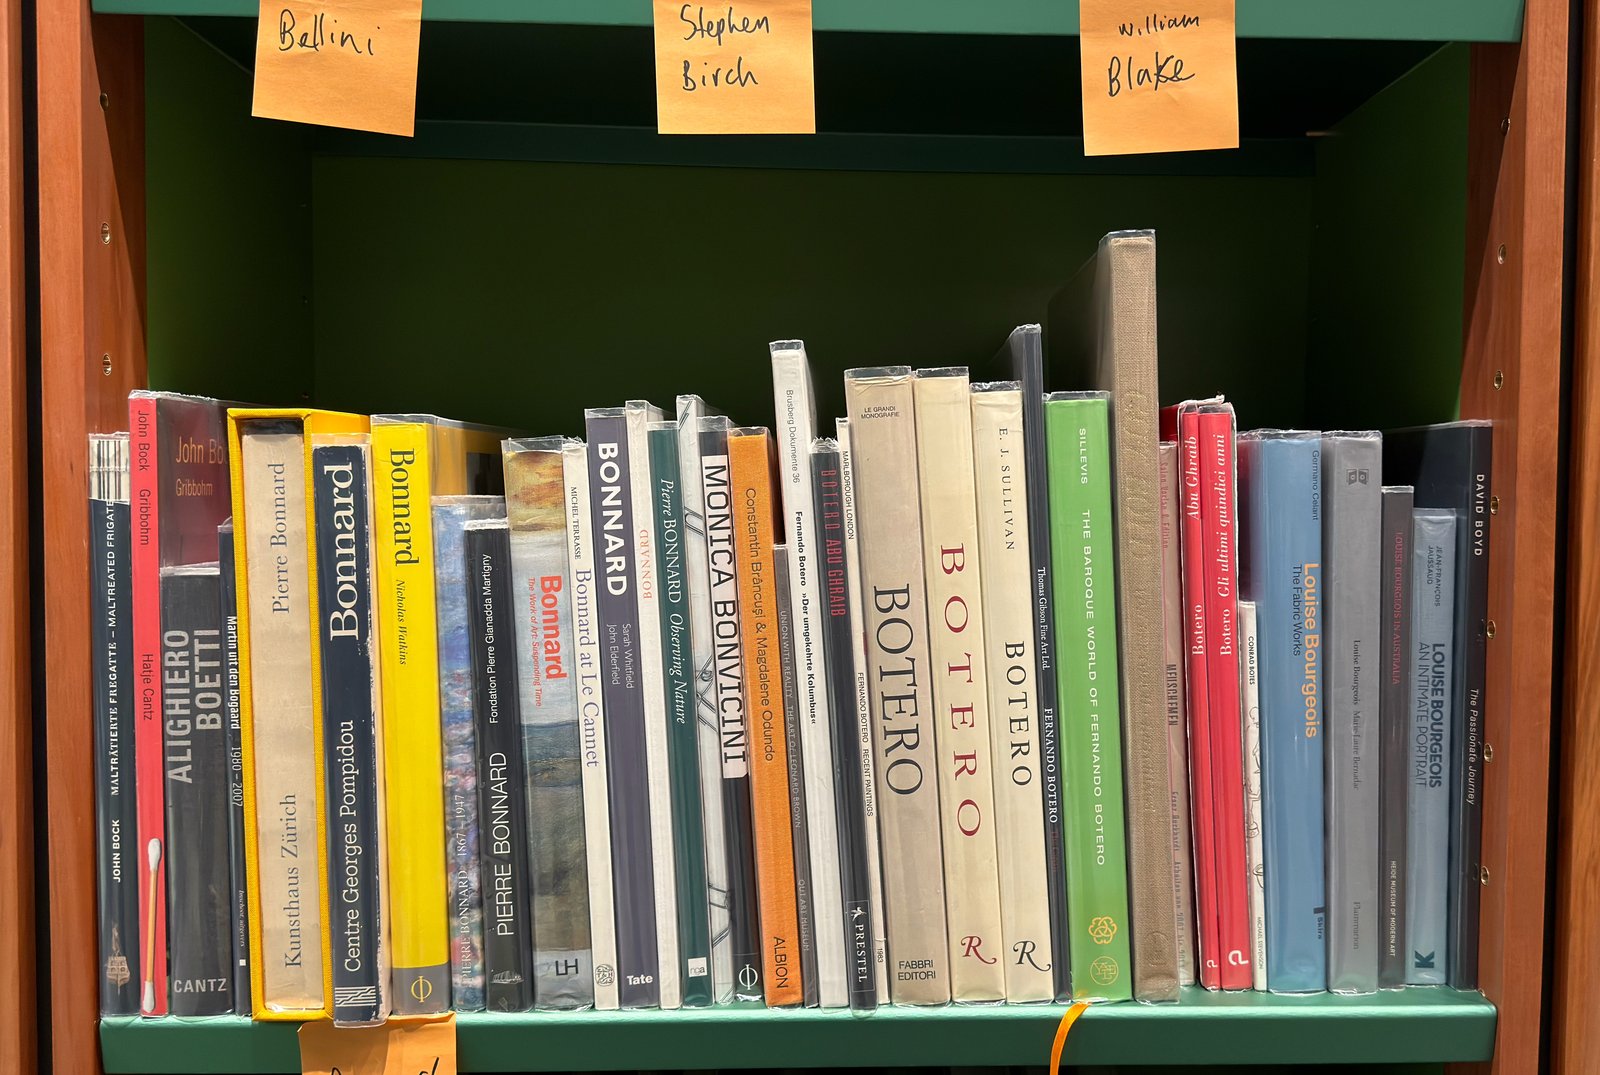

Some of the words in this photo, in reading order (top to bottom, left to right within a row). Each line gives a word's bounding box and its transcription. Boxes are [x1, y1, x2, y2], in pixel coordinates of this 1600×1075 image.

[280, 8, 380, 56] Bellini
[680, 4, 770, 41] Stephen
[682, 57, 758, 91] Birch
[1108, 51, 1196, 97] Blake
[138, 410, 148, 438] John
[786, 390, 794, 425] Brusberg
[860, 411, 900, 419] MONOGRAFIE
[873, 405, 896, 413] GRANDI
[176, 435, 204, 463] John
[788, 426, 798, 472] Dokumente
[999, 427, 1008, 440] E.
[1001, 448, 1009, 457] J.
[1217, 434, 1225, 466] anni
[138, 443, 149, 471] Bock
[1079, 428, 1088, 484] SILLEVIS
[1185, 436, 1198, 495] Ghraib
[176, 478, 213, 497] Gribbohm
[660, 479, 673, 516] Pierre
[792, 472, 799, 484] 36
[842, 451, 851, 508] MARLBOROUGH
[1475, 474, 1485, 514] DAVID
[139, 489, 150, 546] Gribbohm
[270, 463, 288, 547] Bonnard
[390, 448, 420, 567] Bonnard
[571, 486, 580, 518] MICHEL
[821, 469, 837, 530] BOTERO
[1001, 465, 1014, 550] SULLIVAN
[1186, 497, 1198, 520] Abu
[1214, 470, 1230, 528] quindici
[573, 519, 581, 559] TERRASSE
[598, 443, 627, 597] BONNARD
[704, 465, 735, 588] MONICA
[745, 489, 759, 558] Constantin
[795, 512, 803, 553] Fernando
[846, 509, 854, 540] LONDON
[1081, 510, 1091, 539] THE
[1474, 519, 1483, 556] BOYD
[324, 462, 359, 641] Bonnard
[639, 529, 652, 599] BONNARD
[664, 518, 681, 603] BONNARD
[798, 554, 806, 586] Botero
[826, 539, 842, 566] ABU
[1217, 532, 1229, 573] ultimi
[107, 551, 117, 627] MALTREATED
[272, 556, 290, 613] Pierre
[482, 554, 492, 593] Martigny
[828, 568, 845, 617] GHRAIB
[1037, 567, 1046, 596] Thomas
[1083, 546, 1095, 620] BAROQUE
[1217, 577, 1230, 597] Gli
[1293, 564, 1302, 584] The
[396, 580, 406, 623] Nicholas
[529, 593, 537, 614] Work
[576, 569, 596, 647] Bonnard
[1038, 597, 1047, 624] Gibson
[1293, 587, 1302, 620] Fabric
[1304, 563, 1320, 630] Louise
[227, 616, 238, 649] Martin
[485, 597, 495, 644] Gianadda
[530, 615, 537, 624] of
[540, 575, 567, 681] Bonnard
[607, 624, 616, 645] John
[622, 623, 631, 647] Sarah
[757, 624, 766, 633] &
[1040, 625, 1048, 640] Fine
[1192, 604, 1204, 656] Botero
[1220, 608, 1232, 656] Botero
[1292, 621, 1301, 656] Works
[229, 652, 239, 666] uit
[398, 625, 408, 665] Watkins
[486, 645, 495, 674] Pierre
[580, 655, 592, 668] at
[669, 613, 685, 678] Observing
[803, 614, 816, 672] umgekehrte
[1042, 655, 1050, 670] Ltd.
[1087, 626, 1097, 680] WORLD
[1419, 642, 1430, 658] AN
[108, 642, 118, 703] FREGATTE
[142, 654, 154, 682] Hatje
[194, 629, 221, 730] BOETTI
[228, 668, 239, 686] den
[531, 642, 541, 686] Suspending
[609, 646, 620, 685] Elderfield
[623, 648, 634, 689] Whitfield
[714, 600, 746, 764] BONVICINI
[757, 637, 770, 707] Magdalene
[1431, 643, 1446, 696] LOUISE
[142, 688, 155, 720] Cantz
[488, 675, 498, 724] Fondation
[534, 688, 542, 707] Time
[581, 673, 594, 696] Le
[674, 679, 686, 724] Nature
[857, 672, 866, 710] FERNANDO
[873, 583, 923, 795] BOTERO
[940, 542, 981, 837] BOTERO
[1090, 688, 1098, 708] OF
[1303, 634, 1320, 738] Bourgeois
[1352, 666, 1361, 705] Bourgeois
[1416, 660, 1429, 722] INTIMATE
[1469, 688, 1479, 706] The
[164, 630, 193, 783] ALIGHIERO
[228, 689, 240, 729] Bogaard
[1005, 641, 1032, 786] BOTERO
[582, 702, 599, 767] Cannet
[762, 710, 773, 762] Odundo
[860, 711, 868, 743] BOTERO
[1045, 708, 1055, 774] FERNANDO
[1429, 699, 1444, 788] BOURGEOIS
[1468, 708, 1478, 762] Passionate
[231, 747, 242, 770] 1980
[337, 720, 359, 817] Pompidou
[862, 749, 871, 777] RECENT
[1091, 714, 1102, 797] FERNANDO
[1415, 725, 1428, 788] PORTRAIT
[232, 783, 243, 807] 2007
[489, 752, 512, 854] BONNARD
[864, 778, 873, 817] PAINTINGS
[1047, 775, 1058, 823] BOTERO
[1466, 765, 1477, 805] Journey
[112, 819, 120, 850] BOCK
[280, 794, 299, 858] Zürich
[1095, 805, 1105, 865] BOTERO
[113, 852, 121, 883] JOHN
[342, 823, 362, 903] Georges
[284, 867, 302, 968] Kunsthaus
[494, 864, 514, 935] PIERRE
[1390, 908, 1396, 916] OF
[344, 907, 362, 972] Centre
[855, 925, 867, 982] PRESTEL
[627, 974, 653, 986] Tate
[774, 936, 788, 989] ALBION
[898, 959, 934, 970] FABBRI
[898, 970, 936, 981] EDITORI
[174, 978, 227, 993] CANTZ
